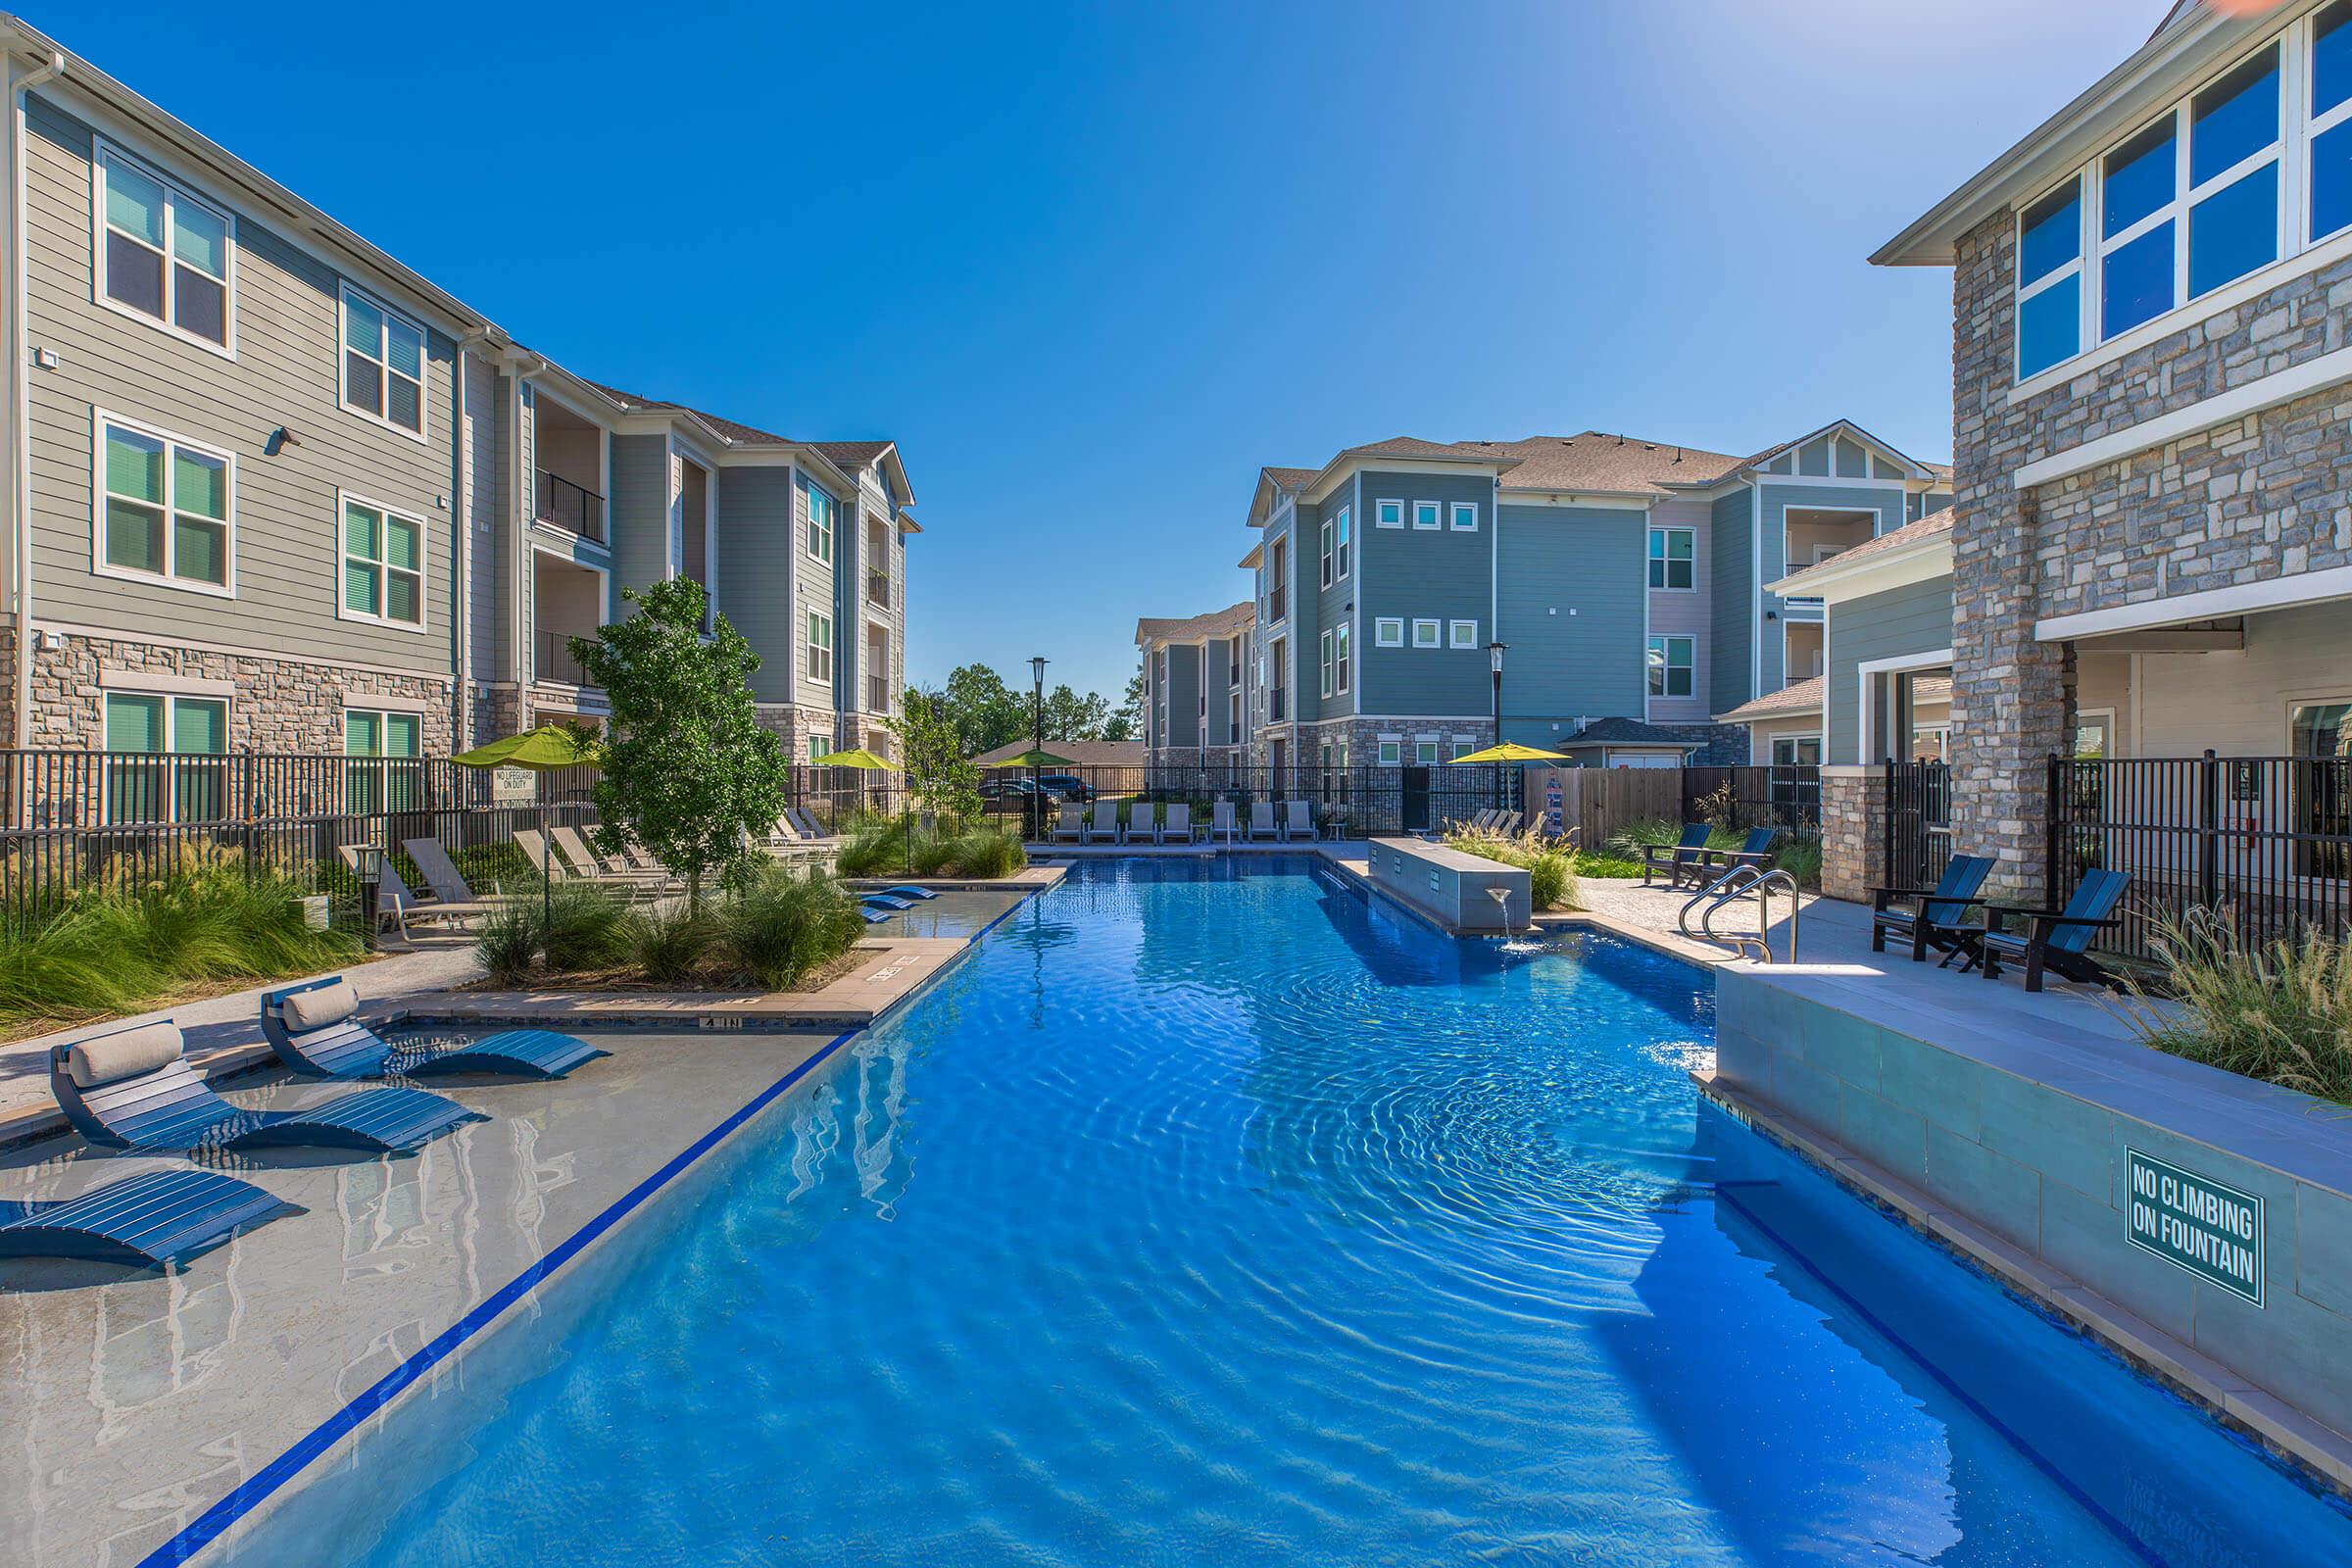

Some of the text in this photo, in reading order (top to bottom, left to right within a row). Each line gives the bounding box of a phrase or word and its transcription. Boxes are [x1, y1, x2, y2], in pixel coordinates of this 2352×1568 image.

[496, 771, 533, 780] NO LIFEGUARD
[504, 780, 526, 789] ON DUTY
[502, 800, 529, 809] NO DIVING
[2133, 1163, 2252, 1240] NO CLIMBING
[2133, 1201, 2253, 1284] ON FOUNTAIN
